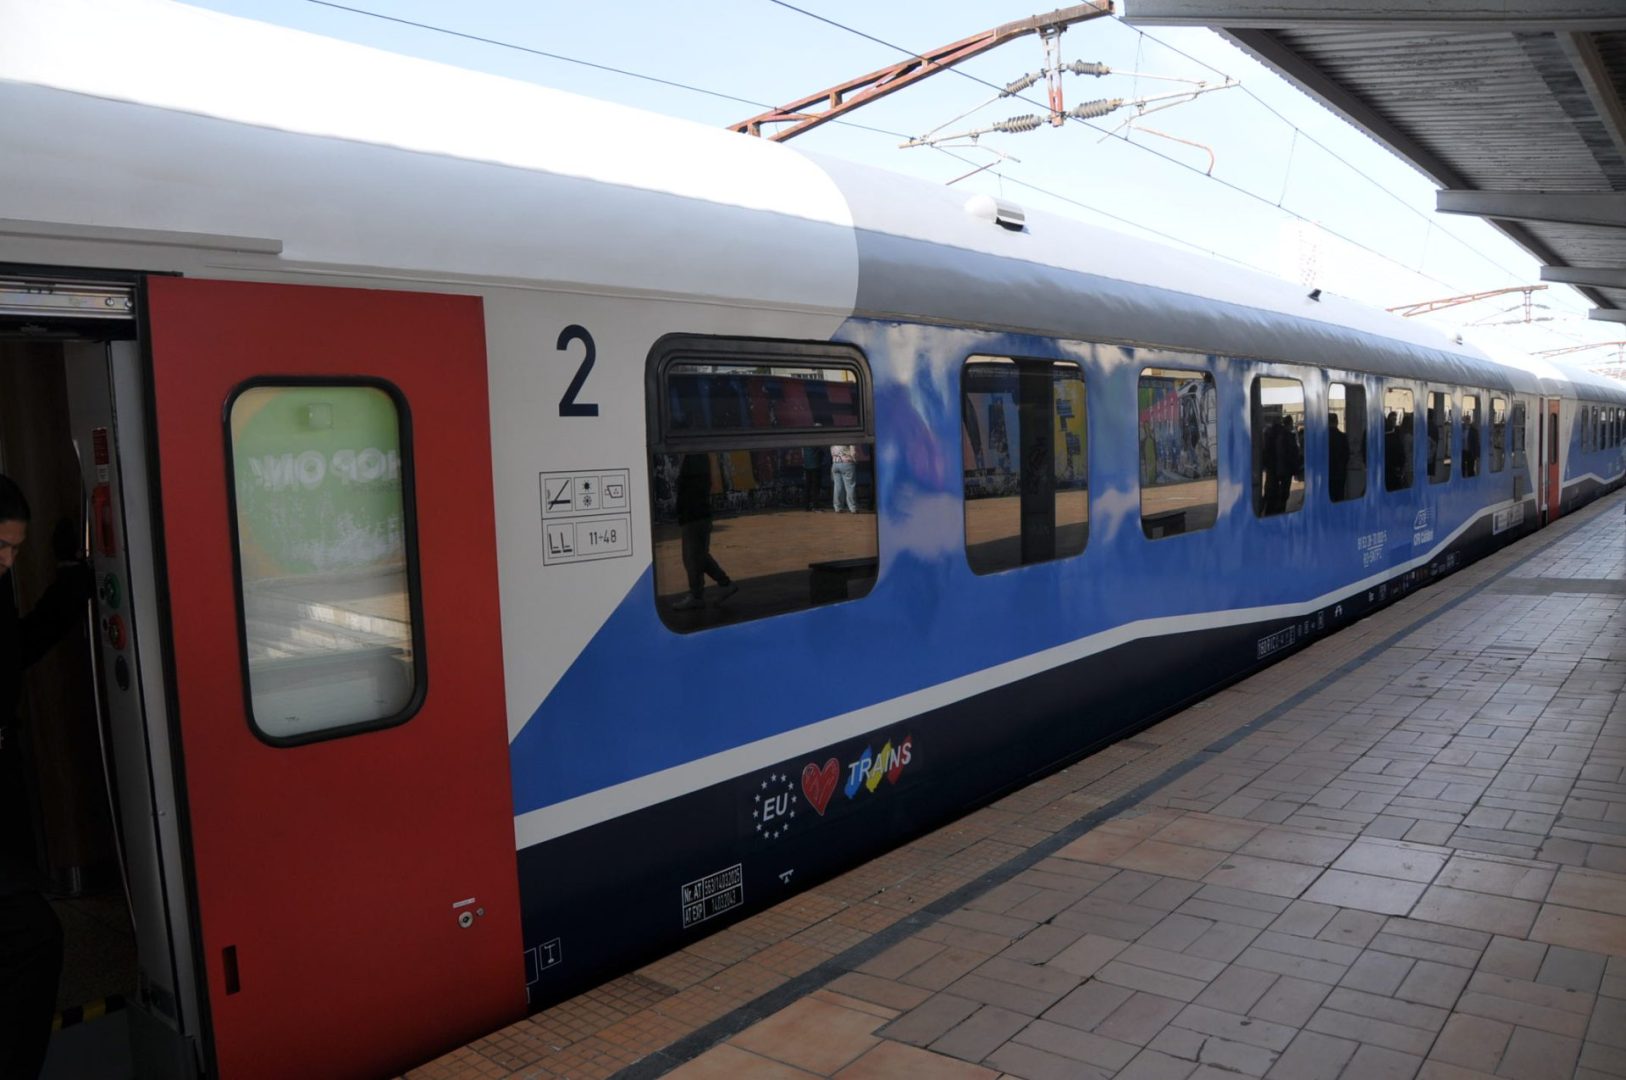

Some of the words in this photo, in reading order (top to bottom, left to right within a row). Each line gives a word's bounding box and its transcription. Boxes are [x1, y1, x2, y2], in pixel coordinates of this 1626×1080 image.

[556, 323, 599, 417] 2
[763, 792, 788, 822] EU
[848, 742, 912, 786] TRAINS
